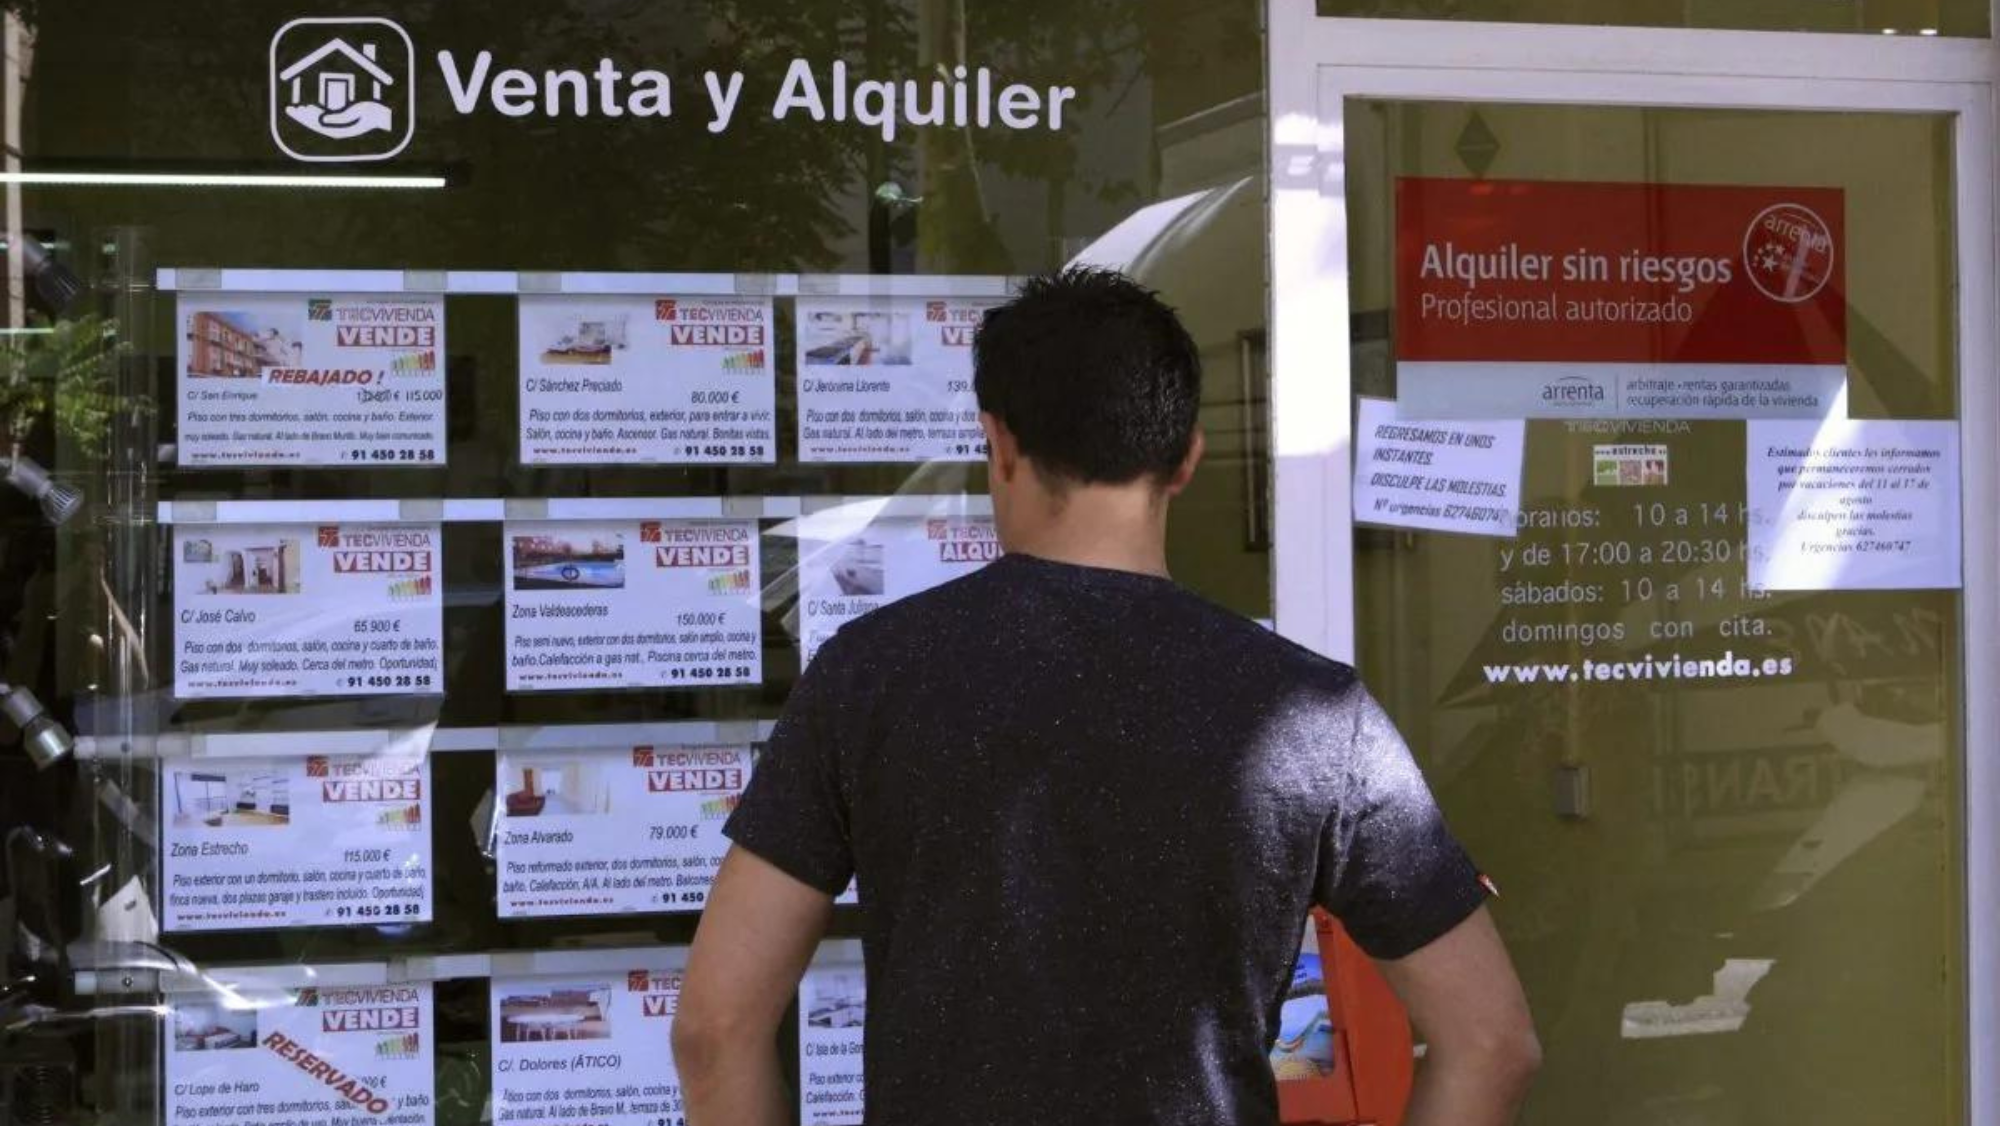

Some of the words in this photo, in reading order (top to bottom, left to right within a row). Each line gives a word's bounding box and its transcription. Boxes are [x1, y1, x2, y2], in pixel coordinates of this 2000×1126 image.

[437, 50, 673, 117] Venta
[704, 71, 745, 133] y
[772, 59, 1075, 143] Alquiler
[1420, 241, 1552, 289] Alquiler
[1562, 247, 1608, 282] sin
[1619, 251, 1733, 292] riesgos
[680, 307, 764, 321] TECVIVIENDA
[1422, 293, 1557, 326] Profesional
[1566, 296, 1693, 323] autorizado
[339, 327, 433, 346] VENDE
[672, 326, 761, 345] VENDE
[268, 369, 373, 387] REBAJADO
[376, 370, 384, 386] !
[526, 379, 538, 392] C/
[539, 378, 579, 393] Sánchez
[582, 379, 622, 392] Preciado
[803, 379, 814, 392] C/
[815, 379, 854, 393] Jerónima
[856, 379, 891, 393] Llorente
[1542, 382, 1604, 401] arrenta
[1626, 379, 1675, 391] arbitraje
[1721, 379, 1791, 394] garantizadas
[691, 391, 729, 404] 80.000
[731, 391, 740, 403] €
[1626, 393, 1699, 408] recuperación
[1702, 393, 1739, 408] rápida
[1741, 394, 1757, 407] de
[1759, 394, 1769, 407] la
[1772, 395, 1819, 408] vivienda
[529, 410, 550, 422] Piso
[553, 412, 570, 422] con
[573, 410, 590, 422] dos
[689, 412, 710, 424] para
[713, 411, 738, 422] entrar
[740, 413, 748, 422] a
[1375, 425, 1448, 445] REGRESAMOS
[1448, 431, 1464, 446] EN
[1464, 433, 1497, 449] UNOS
[351, 449, 366, 460] 91
[371, 449, 395, 460] 450
[399, 449, 415, 460] 28
[419, 449, 435, 460] 58
[685, 446, 699, 456] 91
[704, 446, 726, 456] 450
[730, 445, 746, 456] 28
[750, 445, 764, 456] 58
[1612, 445, 1656, 456] estrecho
[1768, 446, 1821, 458] Estimados
[1823, 447, 1862, 458] clientes
[1864, 447, 1879, 458] les
[1881, 447, 1941, 459] informamos
[1778, 465, 1797, 477] que
[1799, 465, 1885, 477] permaneceremos
[1887, 463, 1931, 474] cerrados
[1371, 472, 1425, 491] DISCULPE
[1425, 478, 1446, 493] LAS
[1778, 480, 1796, 492] por
[1800, 479, 1856, 489] vacaciones
[1858, 479, 1874, 489] del
[1876, 479, 1887, 489] 11
[1891, 479, 1901, 489] al
[1904, 478, 1915, 489] 17
[1917, 478, 1930, 489] de
[1839, 496, 1873, 506] agosto
[1390, 502, 1444, 518] urgencias
[1633, 504, 1665, 526] 10
[1676, 508, 1688, 525] a
[1700, 503, 1728, 525] 14
[1797, 511, 1847, 523] disculpen
[1849, 511, 1864, 520] las
[1866, 511, 1912, 520] molestias
[343, 533, 430, 547] TECVIVIENDA
[666, 528, 748, 542] TECVIVIENDA
[1801, 541, 1853, 554] Urgencias
[1856, 541, 1911, 551] 627460747
[336, 552, 429, 572] VENDE
[658, 546, 748, 566] VENDE
[1500, 550, 1514, 571] y
[1523, 544, 1551, 565] de
[1562, 543, 1631, 565] 17:00
[1639, 547, 1652, 564] a
[1661, 540, 1730, 563] 20:30
[1501, 582, 1603, 604] sábados:
[1621, 578, 1652, 600] 10
[1666, 582, 1679, 599] a
[1697, 578, 1725, 599] 14
[512, 605, 537, 619] Zona
[540, 603, 608, 618] Valdeacederas
[808, 602, 818, 616] C/
[820, 601, 845, 616] Santa
[181, 610, 194, 624] C/
[196, 609, 222, 623] José
[224, 609, 256, 623] Calvo
[677, 613, 715, 626] 150.000
[717, 612, 726, 624] €
[1503, 618, 1625, 646] domingos
[1650, 619, 1694, 638] con
[1719, 615, 1773, 636] cita.
[671, 668, 685, 679] 91
[690, 668, 712, 679] 450
[717, 667, 732, 678] 28
[735, 667, 750, 677] 58
[1483, 651, 1792, 682] www.tecvivienda.es
[348, 677, 362, 687] 91
[368, 676, 390, 687] 450
[397, 676, 411, 687] 28
[415, 675, 431, 686] 58
[657, 752, 741, 766] TECVIVIENDA
[651, 770, 739, 790] VENDE
[325, 779, 419, 801] VENDE
[504, 831, 529, 845] Zona
[531, 830, 574, 844] Alvarado
[649, 825, 688, 839] 79.000
[690, 825, 699, 838] €
[171, 843, 197, 857] Zona
[201, 841, 249, 856] Estrecho
[344, 849, 381, 862] 115.000
[382, 849, 392, 861] €
[662, 893, 676, 903] 91
[681, 892, 704, 903] 450
[337, 906, 351, 917] 91
[357, 906, 381, 917] 450
[385, 905, 400, 916] 28
[404, 904, 420, 915] 58
[324, 1008, 417, 1030] VENDE
[519, 1056, 568, 1071] Dolores
[571, 1053, 622, 1072] (ÁTICO)
[262, 1031, 388, 1115] RESERVADO
[174, 1083, 188, 1095] C/
[189, 1083, 216, 1097] Lope
[218, 1082, 230, 1094] de
[233, 1081, 260, 1093] Haro
